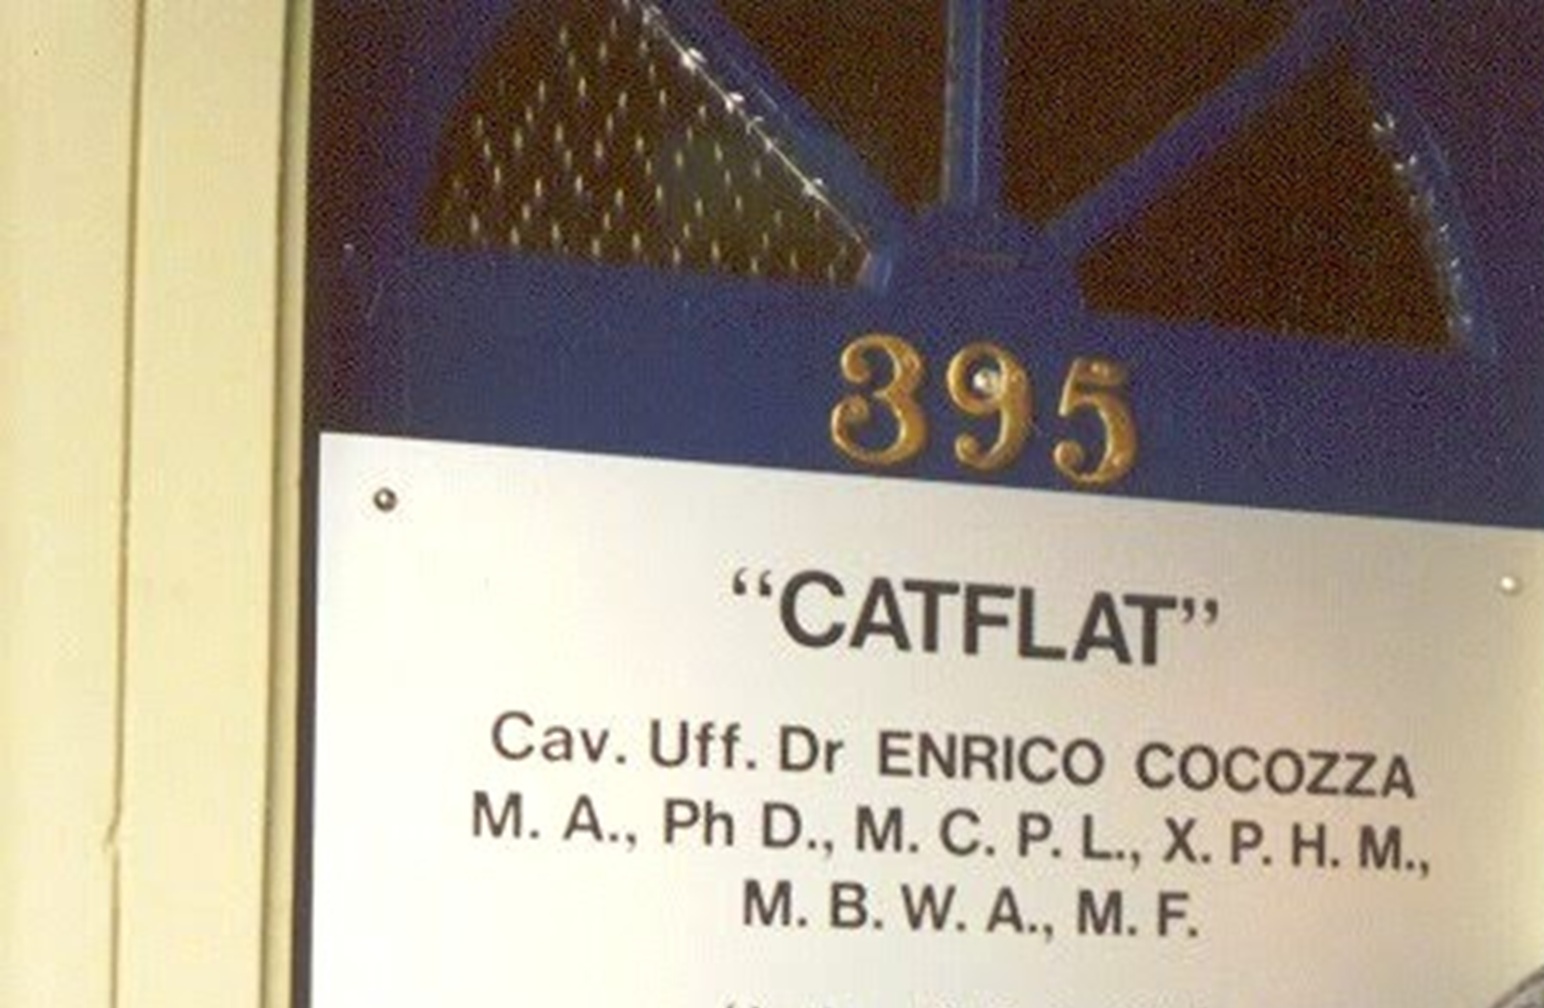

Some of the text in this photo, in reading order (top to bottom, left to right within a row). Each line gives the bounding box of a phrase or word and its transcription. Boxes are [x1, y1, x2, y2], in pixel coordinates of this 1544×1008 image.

[830, 332, 1137, 484] 395
[732, 567, 1218, 666] “CATFLAT”
[491, 710, 1416, 799] Cav. Uff. Dr ENRICO COCOZZA
[473, 790, 1429, 877] M. A., Ph D., M. C. P. L., X. P. H. M.,
[743, 878, 1198, 942] M. B. W. A., M. F.
